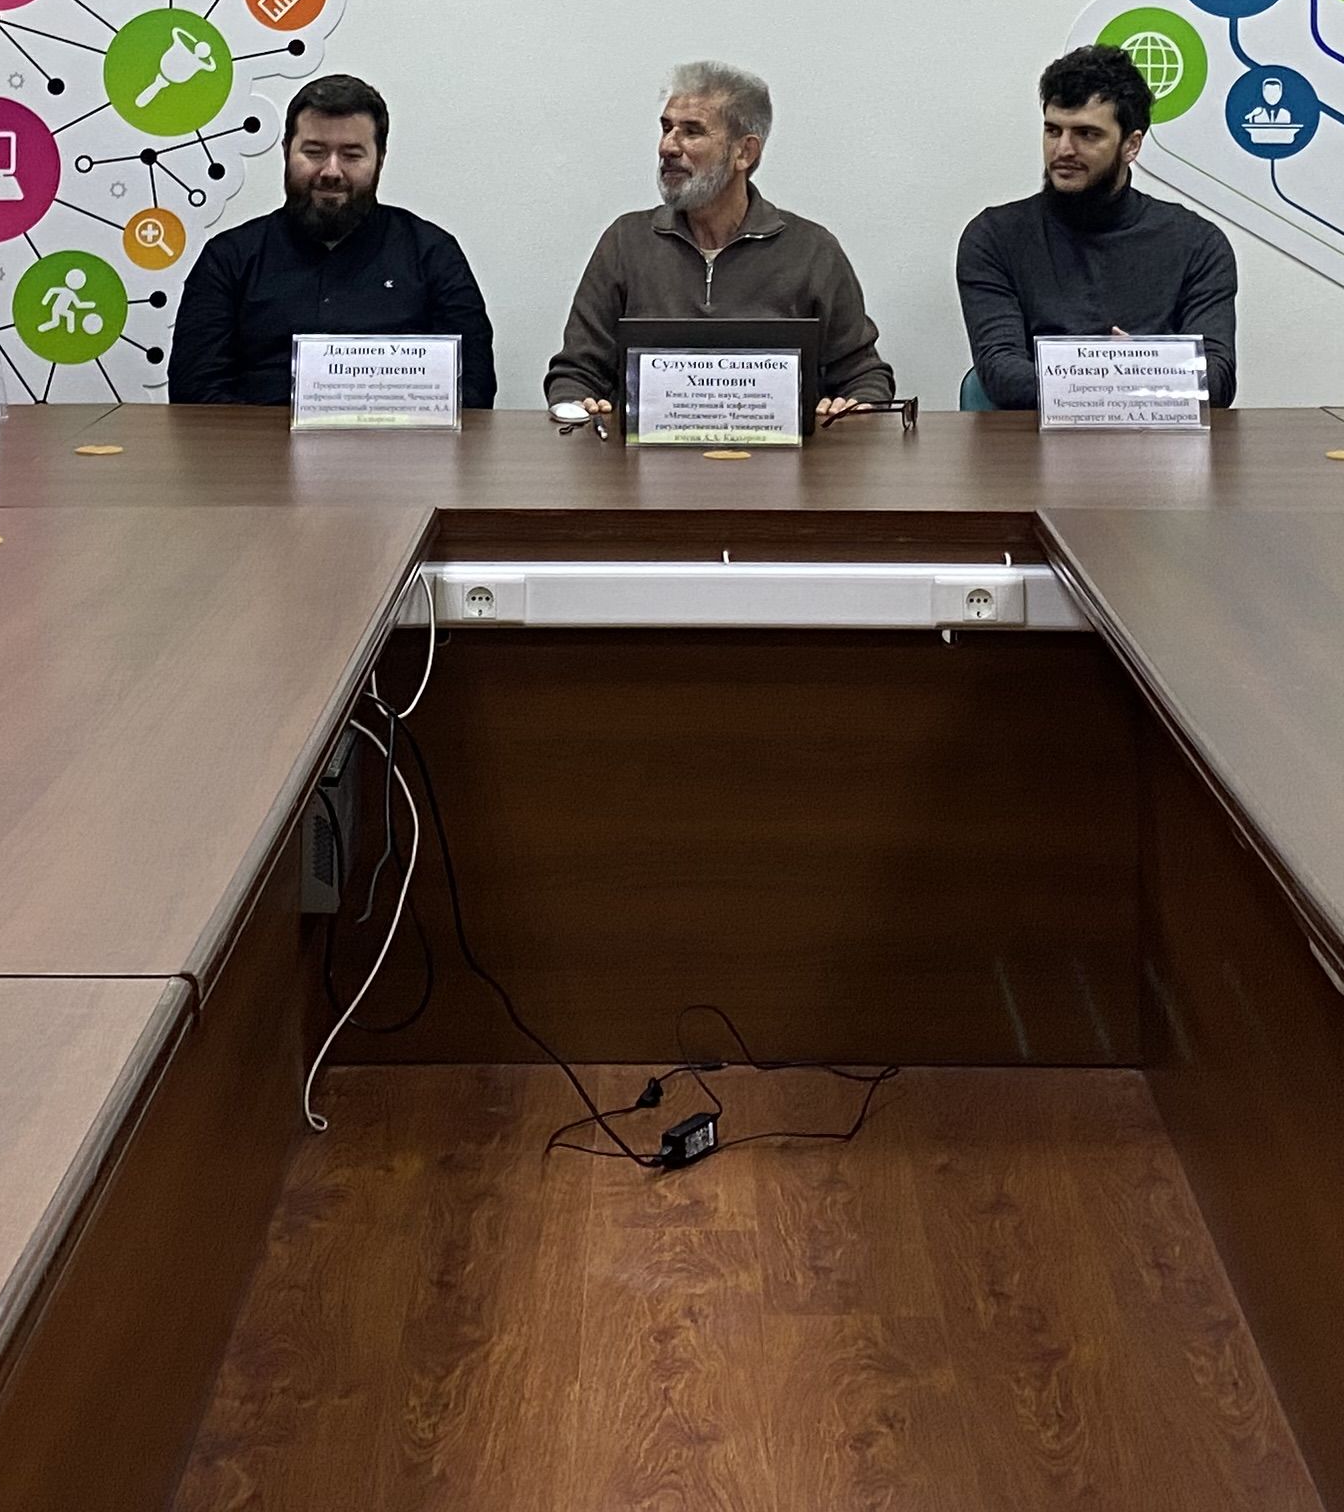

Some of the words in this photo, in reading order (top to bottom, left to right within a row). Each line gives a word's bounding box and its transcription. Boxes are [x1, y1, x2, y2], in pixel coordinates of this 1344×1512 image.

[389, 344, 427, 358] Умар
[1077, 347, 1159, 361] Кагерманов
[717, 357, 789, 371] Саламбек
[1044, 365, 1109, 379] Абубакар
